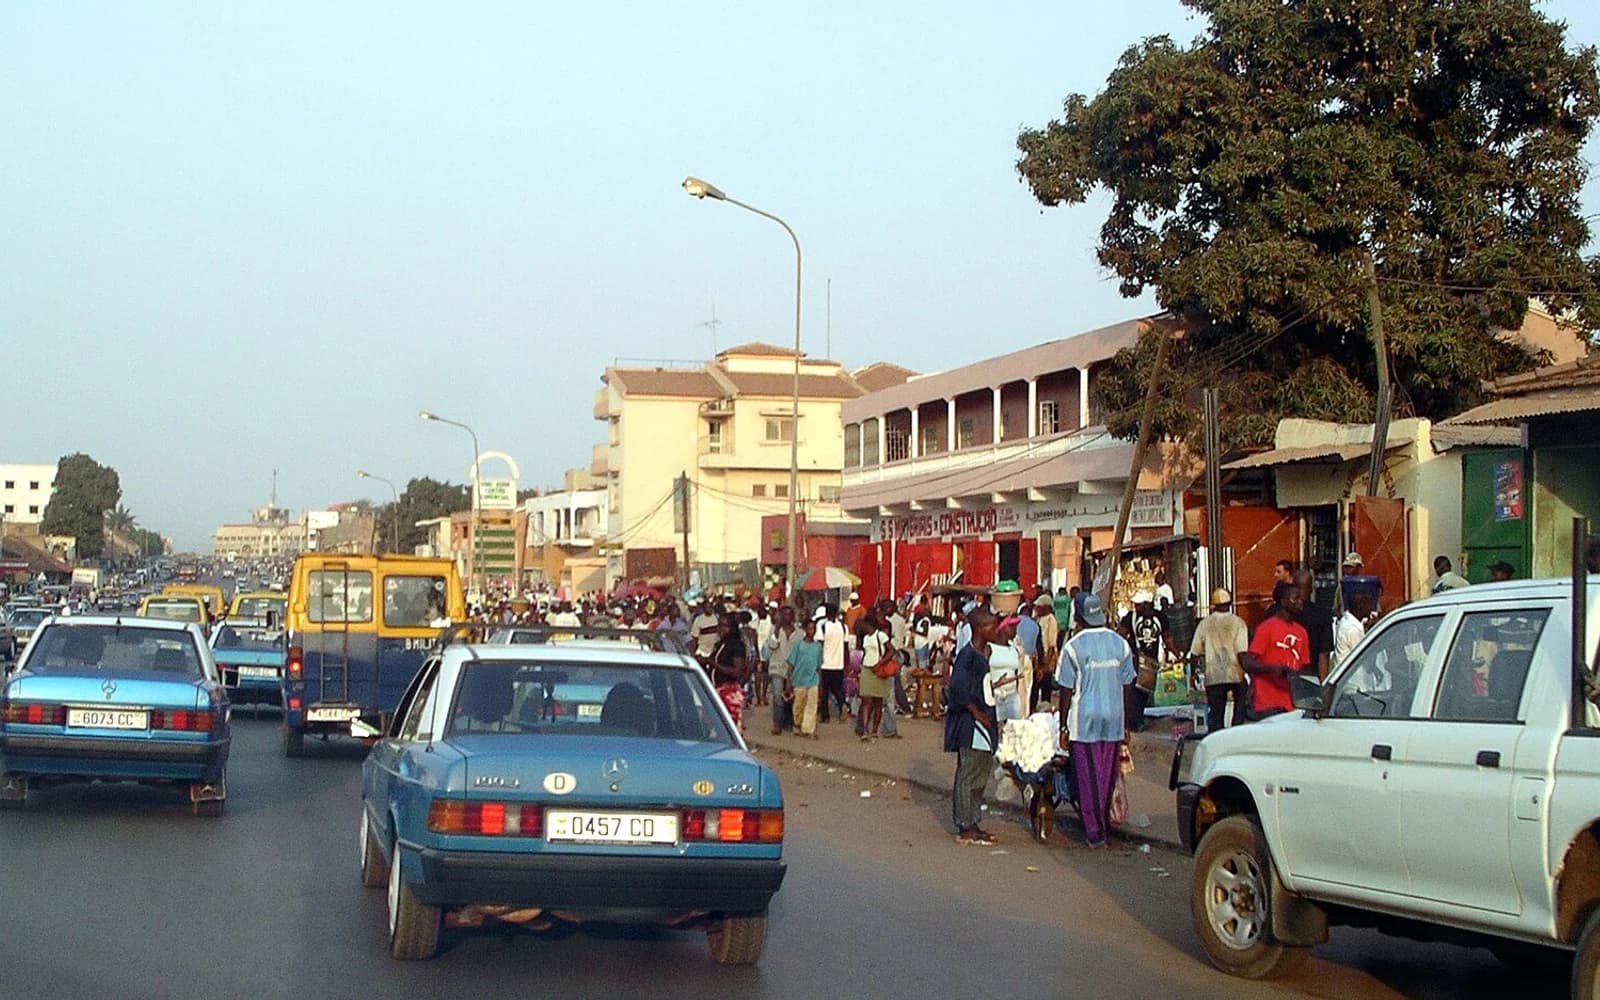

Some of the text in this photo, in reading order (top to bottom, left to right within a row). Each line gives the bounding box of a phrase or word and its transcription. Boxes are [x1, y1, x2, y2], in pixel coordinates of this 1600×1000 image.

[83, 711, 134, 726] 6073 CC
[554, 774, 566, 790] D
[572, 816, 654, 837] 0457 CD
